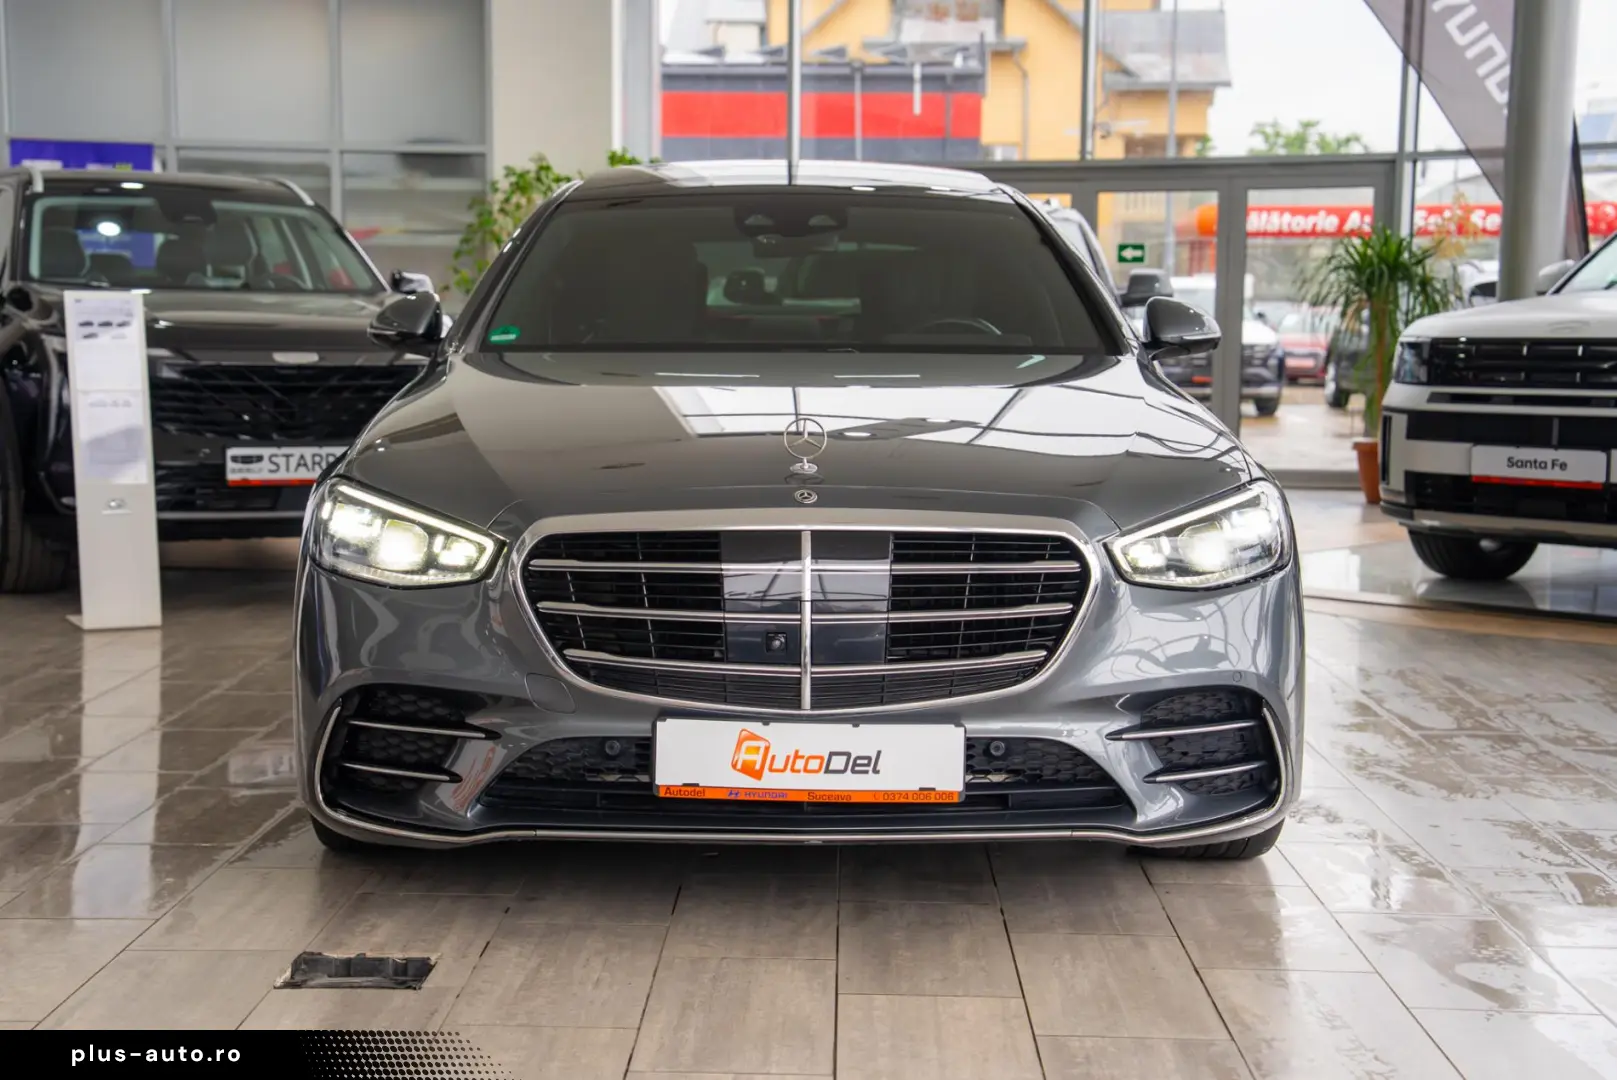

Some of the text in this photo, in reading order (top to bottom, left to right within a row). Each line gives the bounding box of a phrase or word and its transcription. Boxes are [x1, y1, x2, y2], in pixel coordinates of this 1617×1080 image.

[1506, 456, 1568, 471] Santa Fe
[734, 737, 882, 776] AutoDel
[664, 787, 706, 797] Autodel
[744, 791, 788, 799] HYUNDAI
[807, 791, 852, 801] Suceava
[882, 792, 909, 801] 0374
[934, 792, 954, 801] 006
